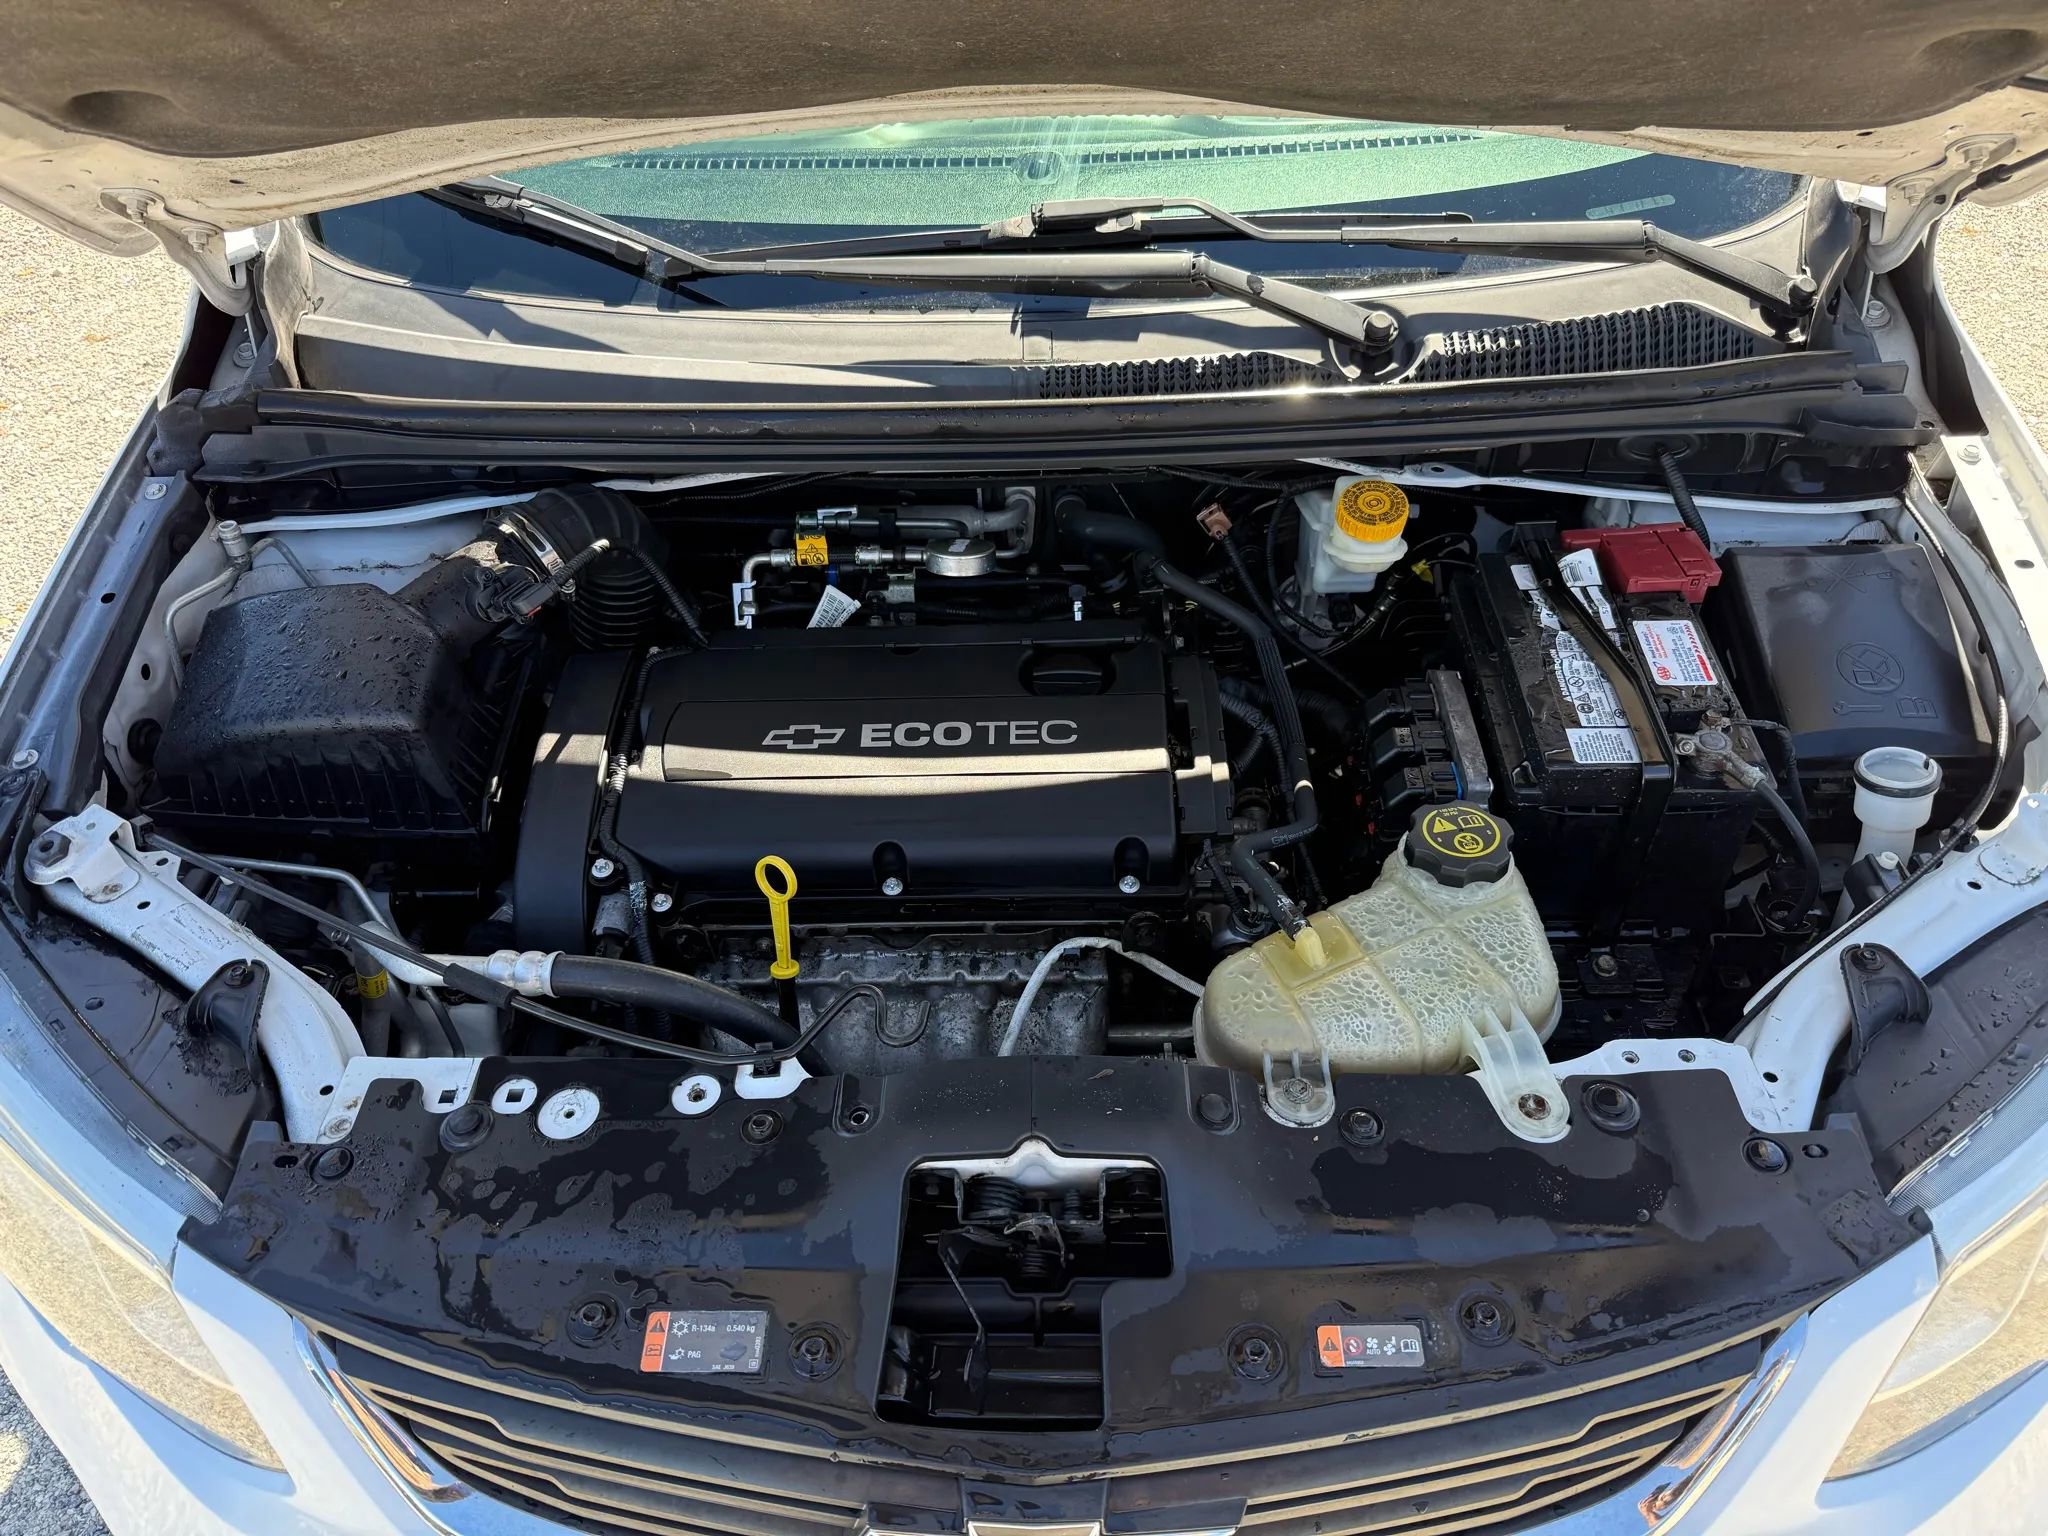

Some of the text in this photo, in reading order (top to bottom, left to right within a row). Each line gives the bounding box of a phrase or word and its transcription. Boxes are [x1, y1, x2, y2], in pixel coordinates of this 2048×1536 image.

[860, 719, 1078, 748] ECOTEC
[691, 1324, 756, 1334] R-134a 0.540 kg
[687, 1350, 702, 1359] PAG
